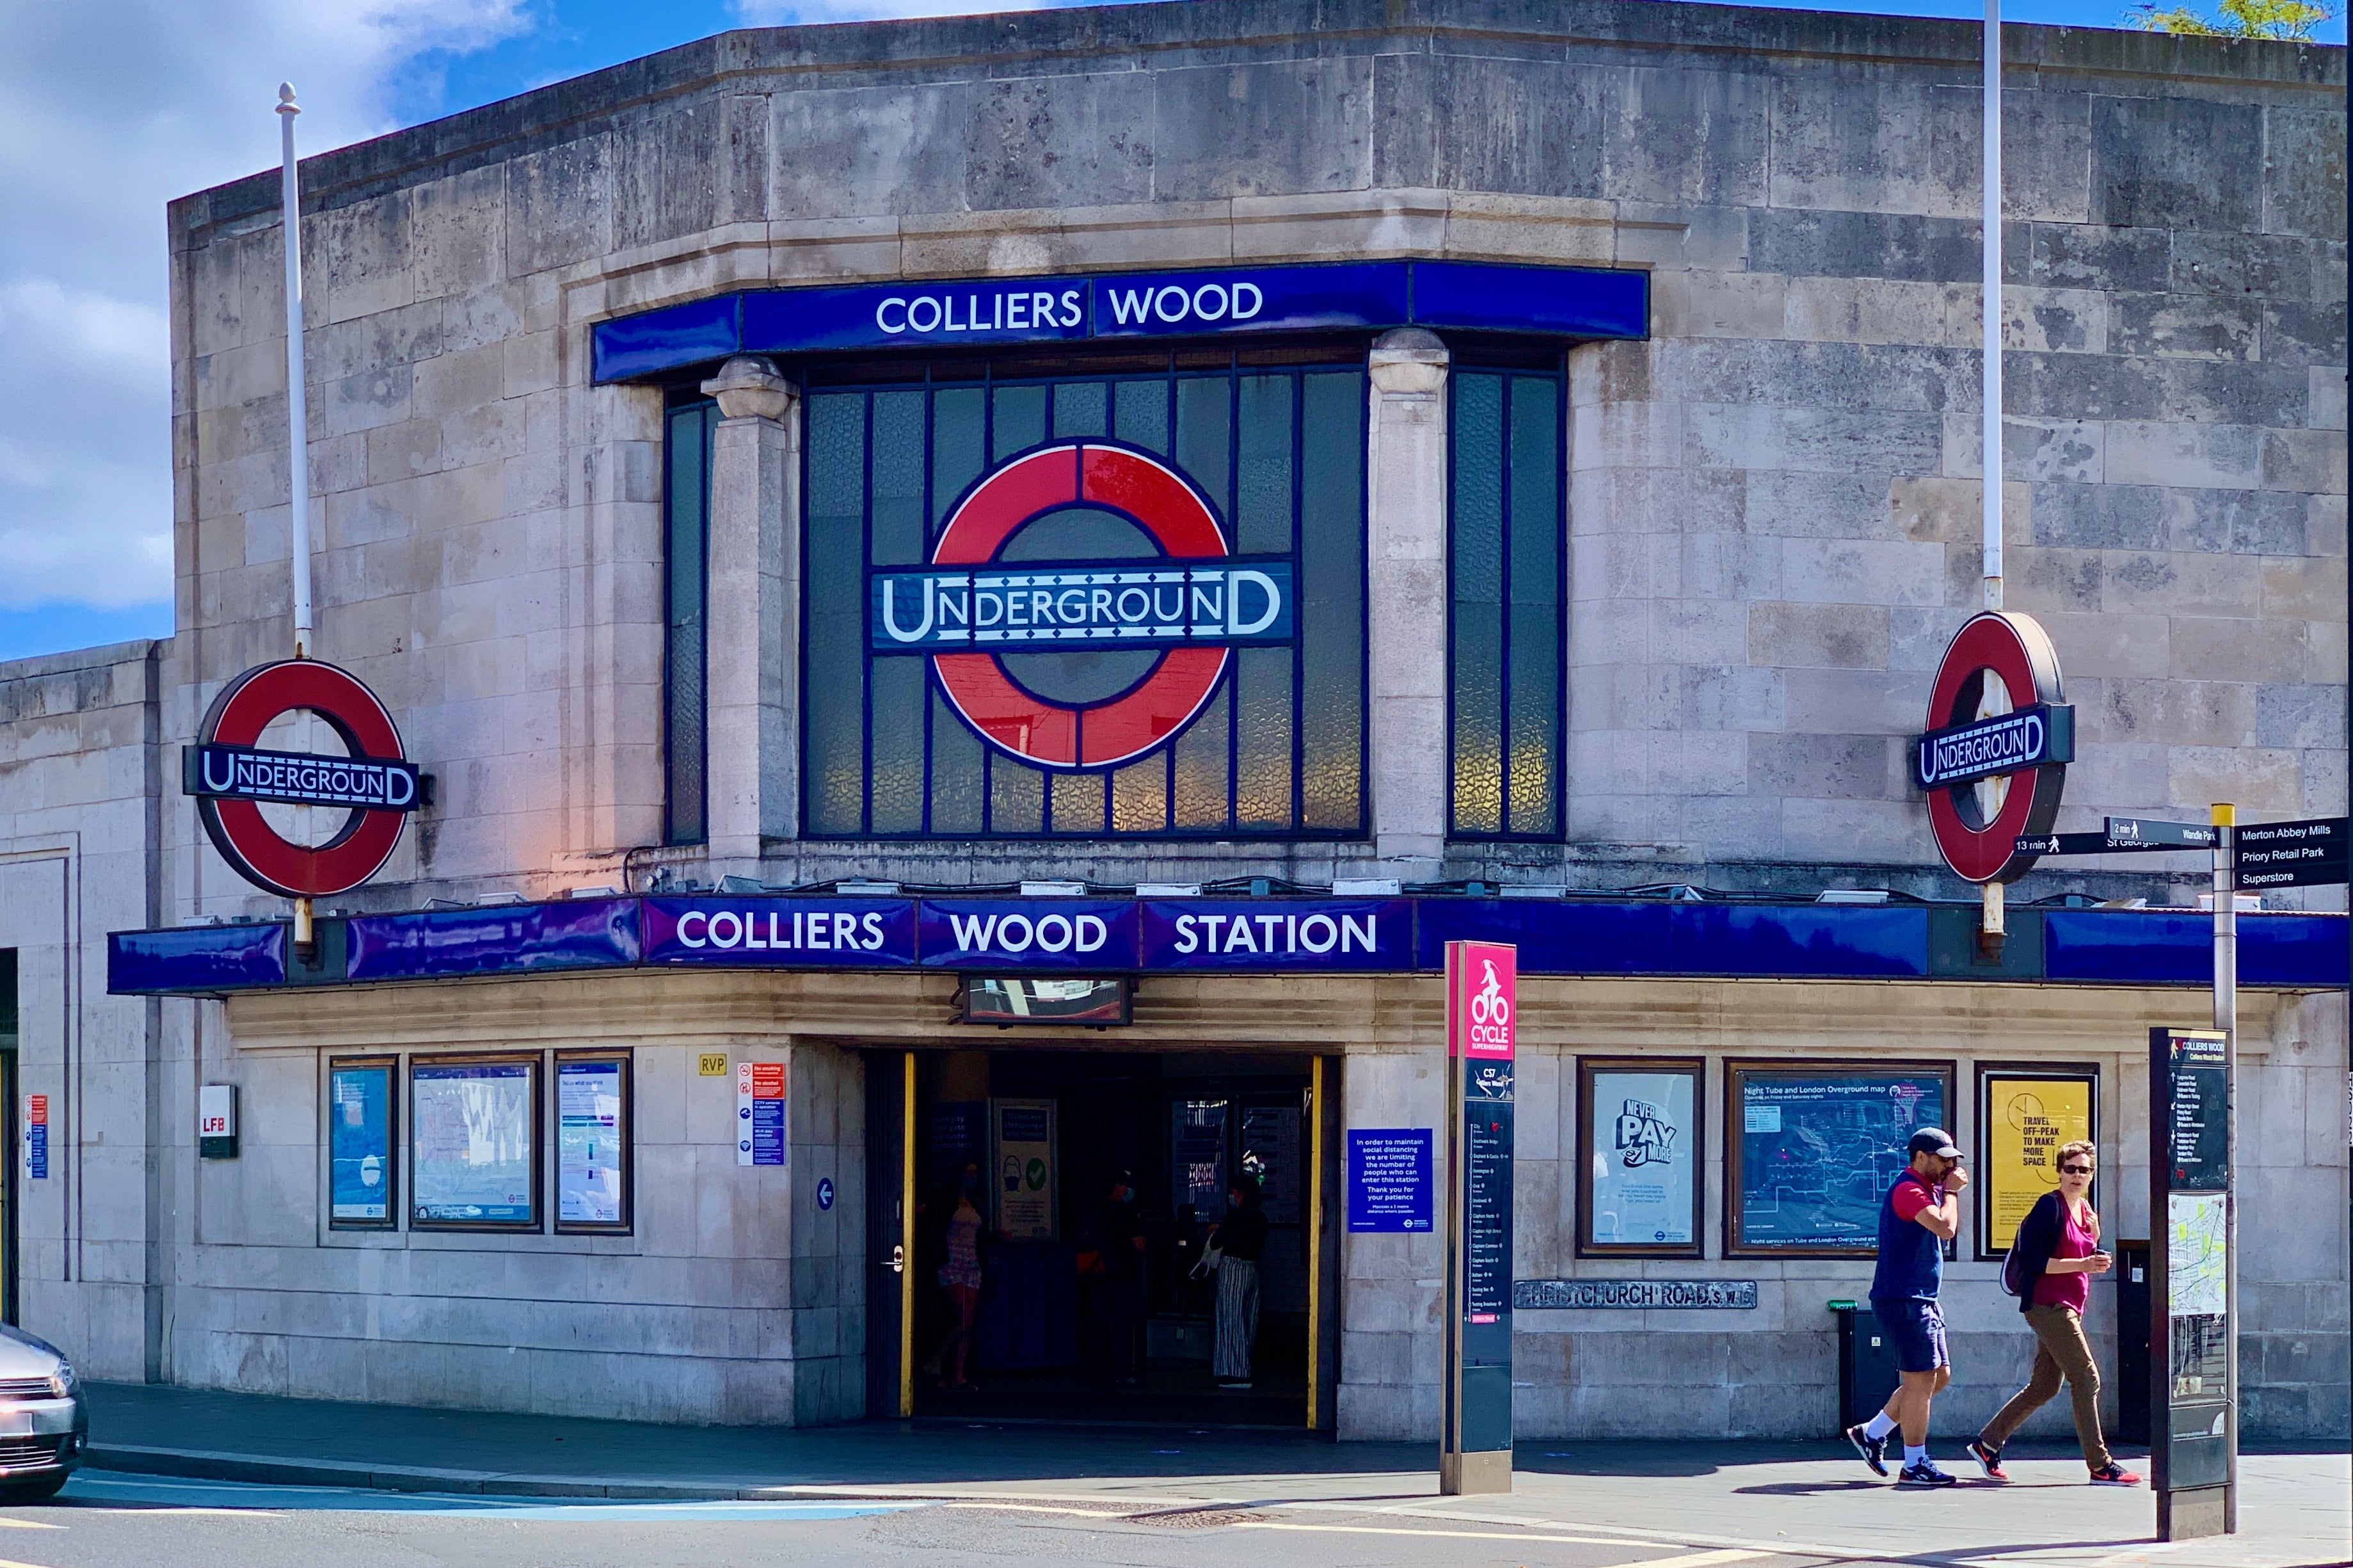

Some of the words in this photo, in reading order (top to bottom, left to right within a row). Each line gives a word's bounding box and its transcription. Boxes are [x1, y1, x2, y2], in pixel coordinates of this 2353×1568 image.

[876, 290, 1081, 333] COLLIERS
[1108, 283, 1263, 324] WOOD
[883, 570, 1280, 642] UNDERGROUND
[1921, 715, 2043, 783] UNDERGROUND
[204, 752, 413, 805] UNDERGROUND
[2114, 824, 2119, 833] 2
[2119, 824, 2130, 834] min
[2183, 829, 2203, 840] Wandle
[2203, 832, 2216, 841] Park
[2242, 831, 2275, 841] Merton
[2276, 828, 2307, 838] Abbey
[2309, 825, 2331, 835] Mills
[2016, 841, 2027, 850] 13
[2029, 841, 2046, 850] min
[2242, 852, 2270, 862] Priory
[2272, 849, 2299, 860] Retail
[2302, 847, 2324, 858] Park
[2242, 873, 2293, 885] Superstore
[676, 911, 884, 950] COLLIERS
[950, 914, 1108, 953] WOOD
[1174, 914, 1376, 953] STATION
[1471, 1025, 1508, 1043] CYCLE
[1472, 1043, 1508, 1051] SUPERHIGHWAY
[2183, 1041, 2208, 1051] COLLIERS
[2208, 1043, 2224, 1052] WOOD
[702, 1058, 724, 1071] RVP
[1483, 1068, 1496, 1077] CS7
[1744, 1087, 1764, 1095] Night
[1827, 1086, 1869, 1094] Overground
[1626, 1099, 1655, 1119] NEVER
[203, 1118, 224, 1132] LFB
[2023, 1117, 2050, 1125] TRAVEL
[1621, 1115, 1677, 1149] PAY
[2023, 1127, 2059, 1136] OFF-PEAK
[2034, 1137, 2055, 1145] MAKE
[1647, 1143, 1671, 1162] MORE
[2023, 1148, 2044, 1156] MORE
[2023, 1157, 2046, 1166] SPACE
